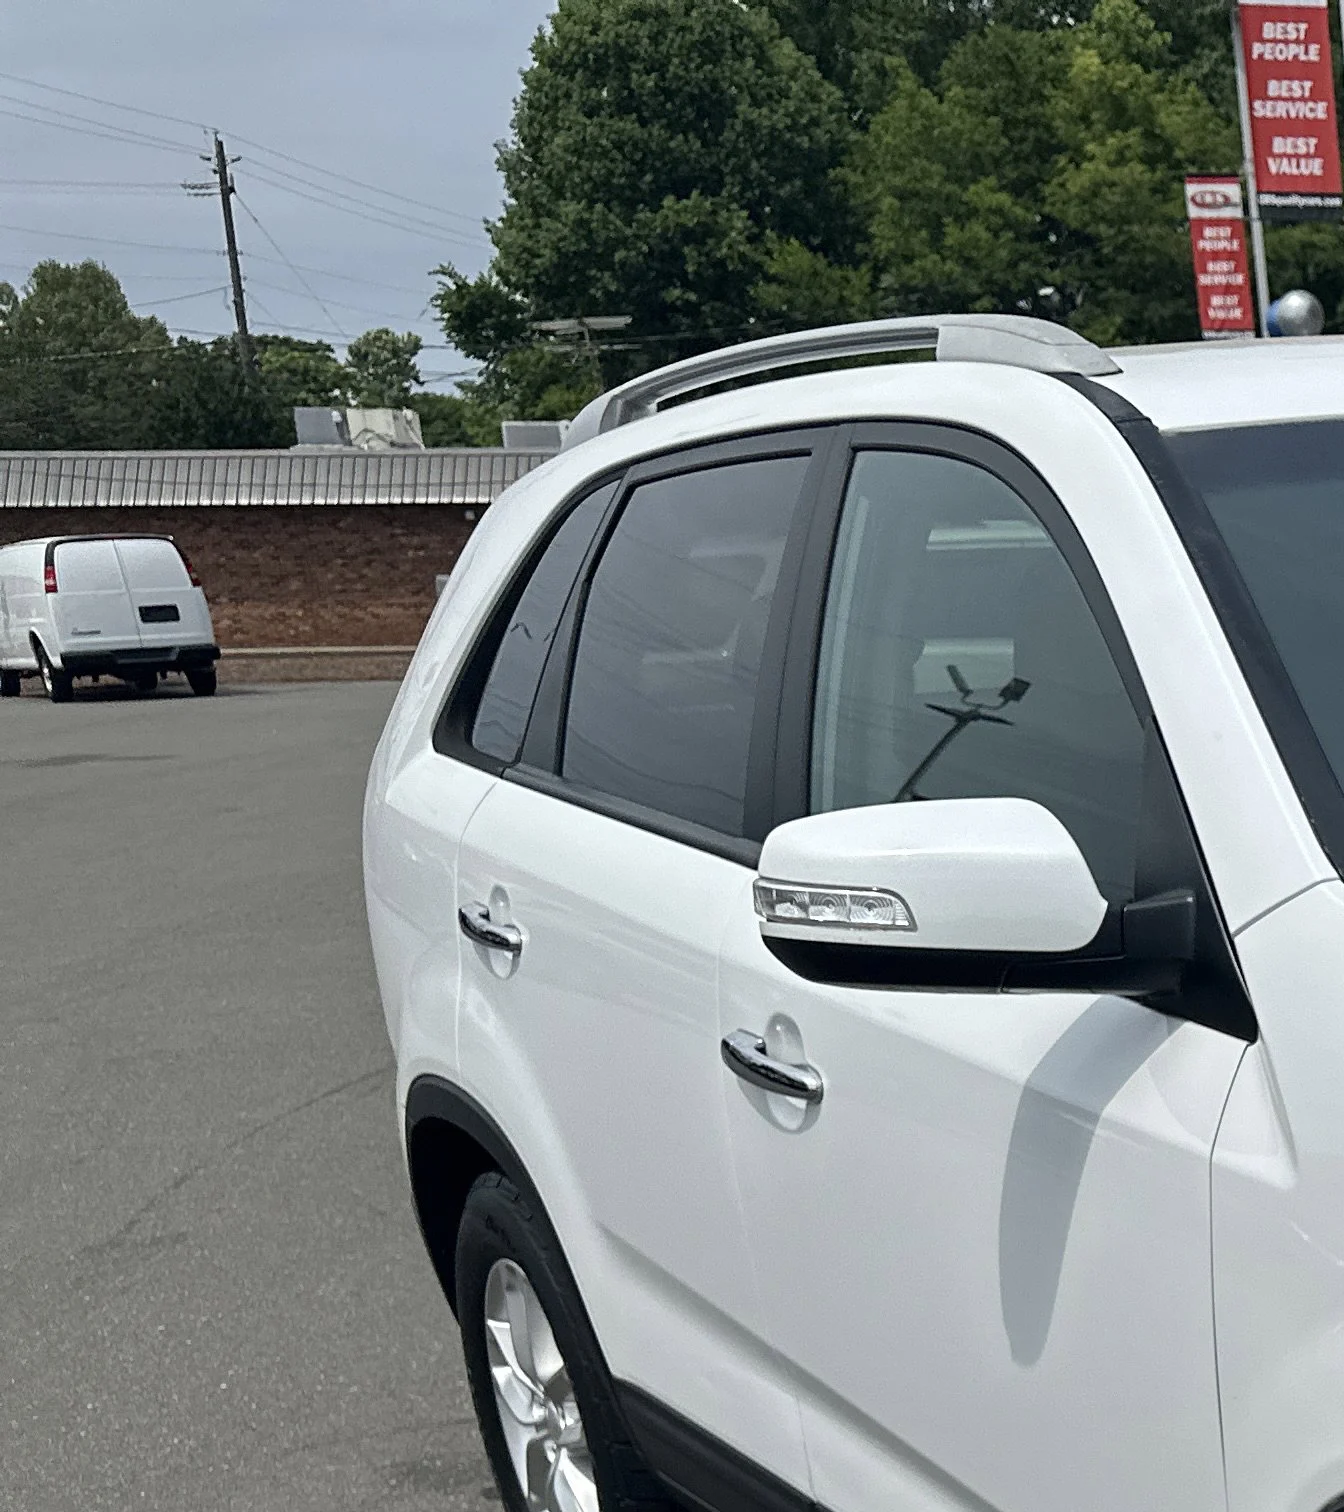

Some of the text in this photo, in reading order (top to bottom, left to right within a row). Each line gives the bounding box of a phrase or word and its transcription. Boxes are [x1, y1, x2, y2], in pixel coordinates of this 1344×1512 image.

[1262, 22, 1308, 40] BEST
[1251, 42, 1321, 61] PEOPLE
[1267, 80, 1313, 98] BEST
[1252, 100, 1328, 119] SERVICE
[1272, 136, 1318, 154] BEST
[1265, 157, 1324, 176] VALUE
